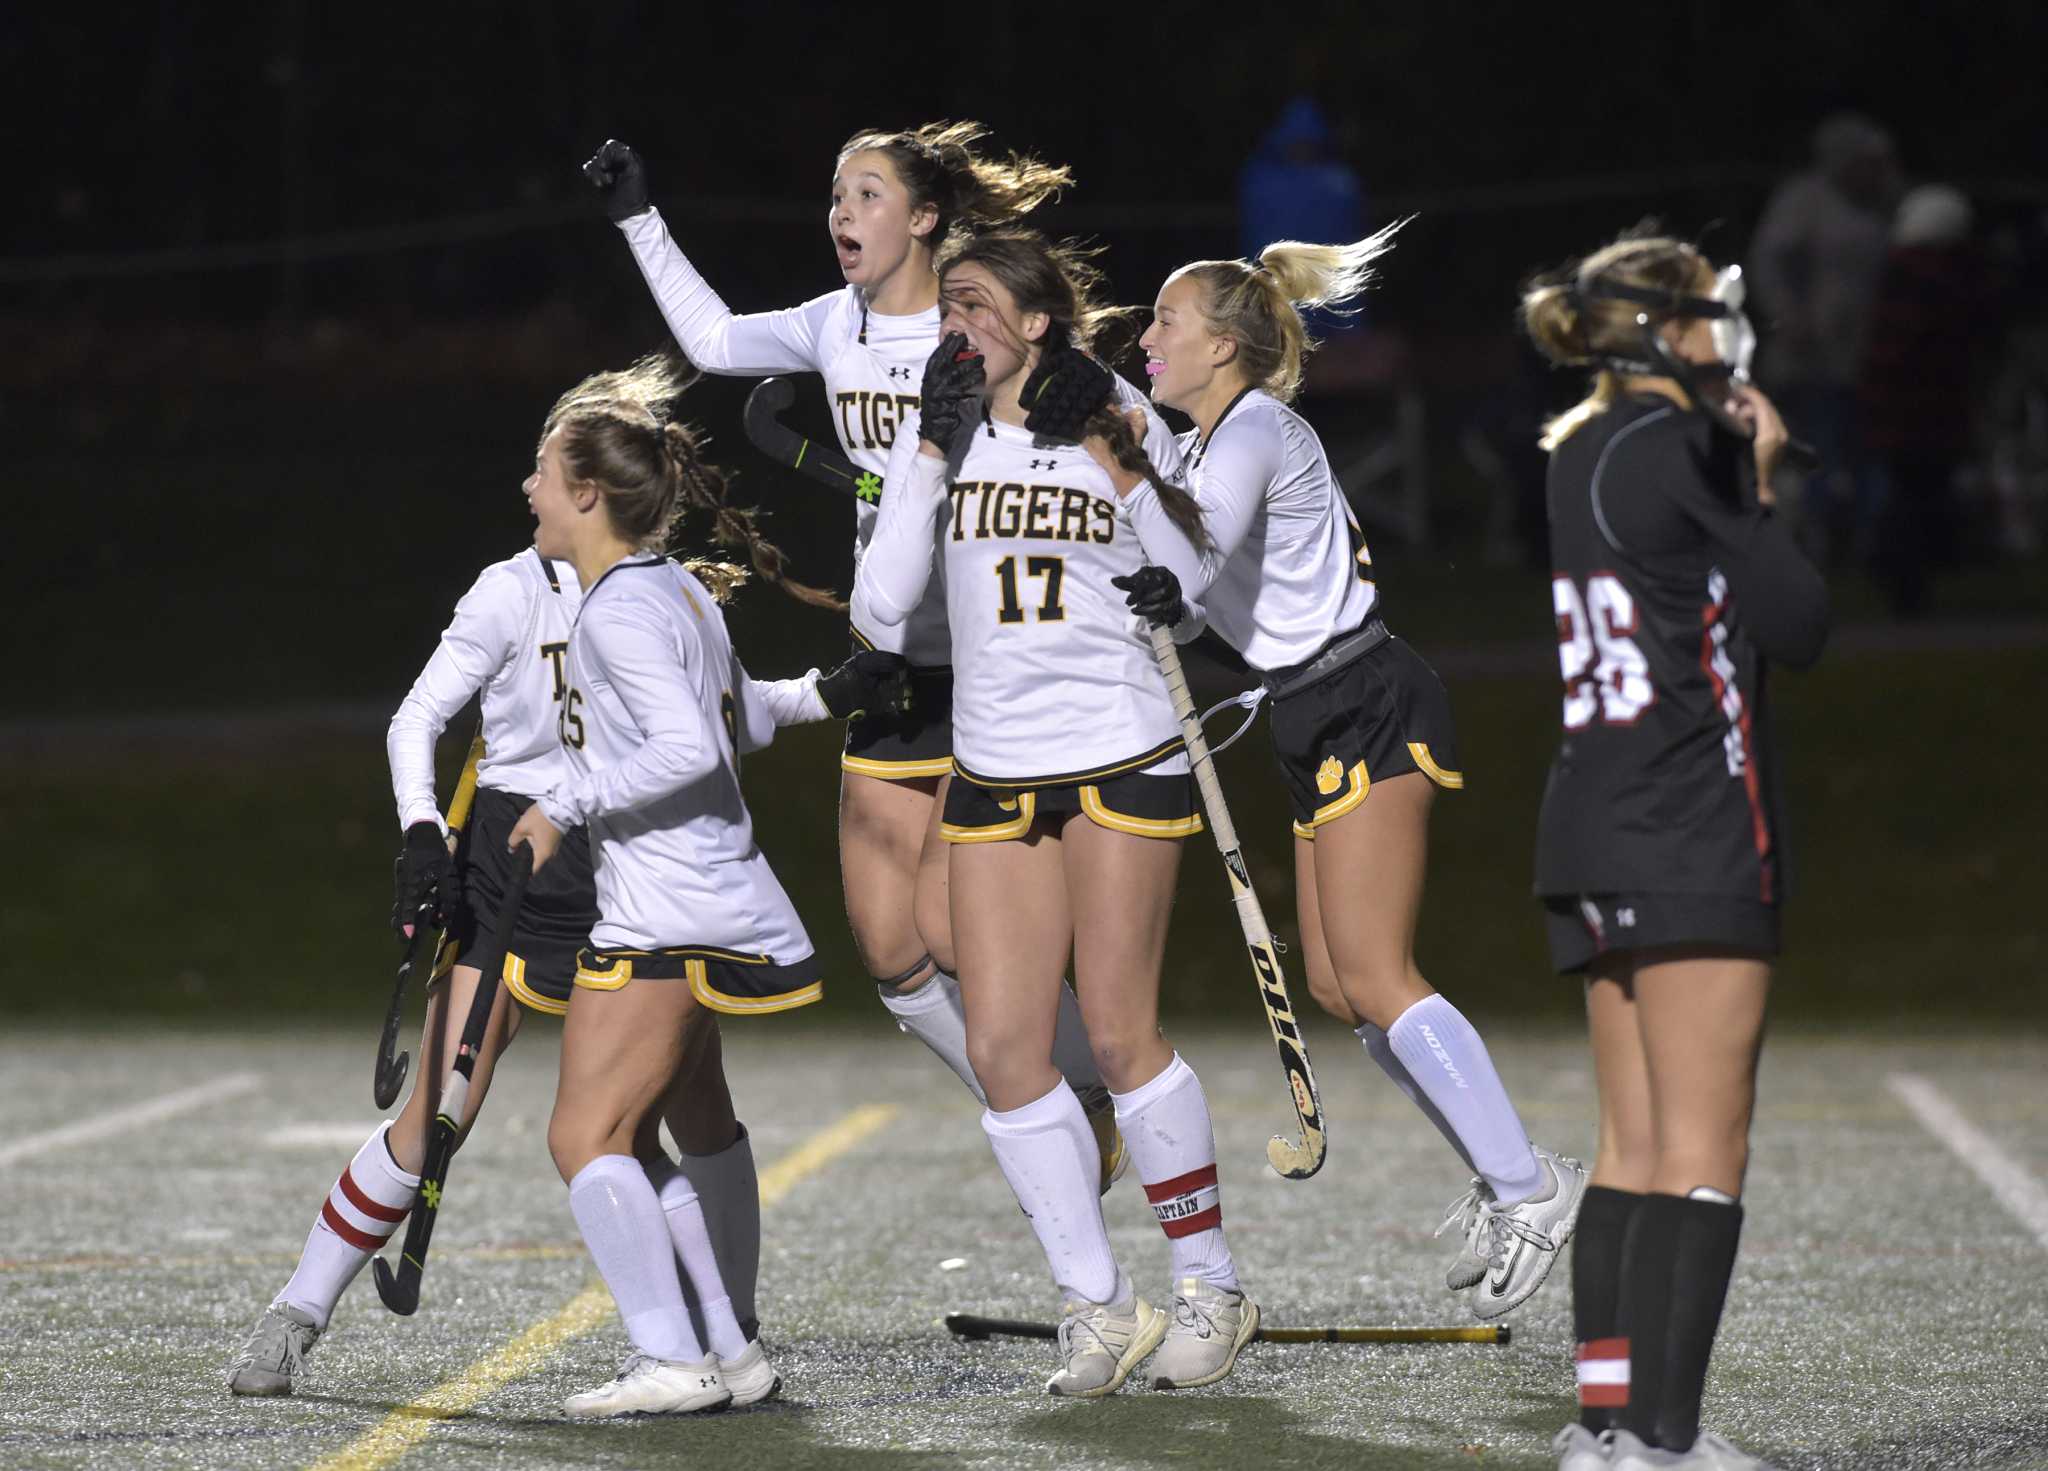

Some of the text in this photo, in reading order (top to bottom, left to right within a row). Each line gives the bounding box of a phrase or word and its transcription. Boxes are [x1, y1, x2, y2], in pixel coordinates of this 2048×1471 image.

[950, 480, 1116, 545] TIGERS
[995, 555, 1067, 625] 17
[1419, 1023, 1470, 1089] MAZON
